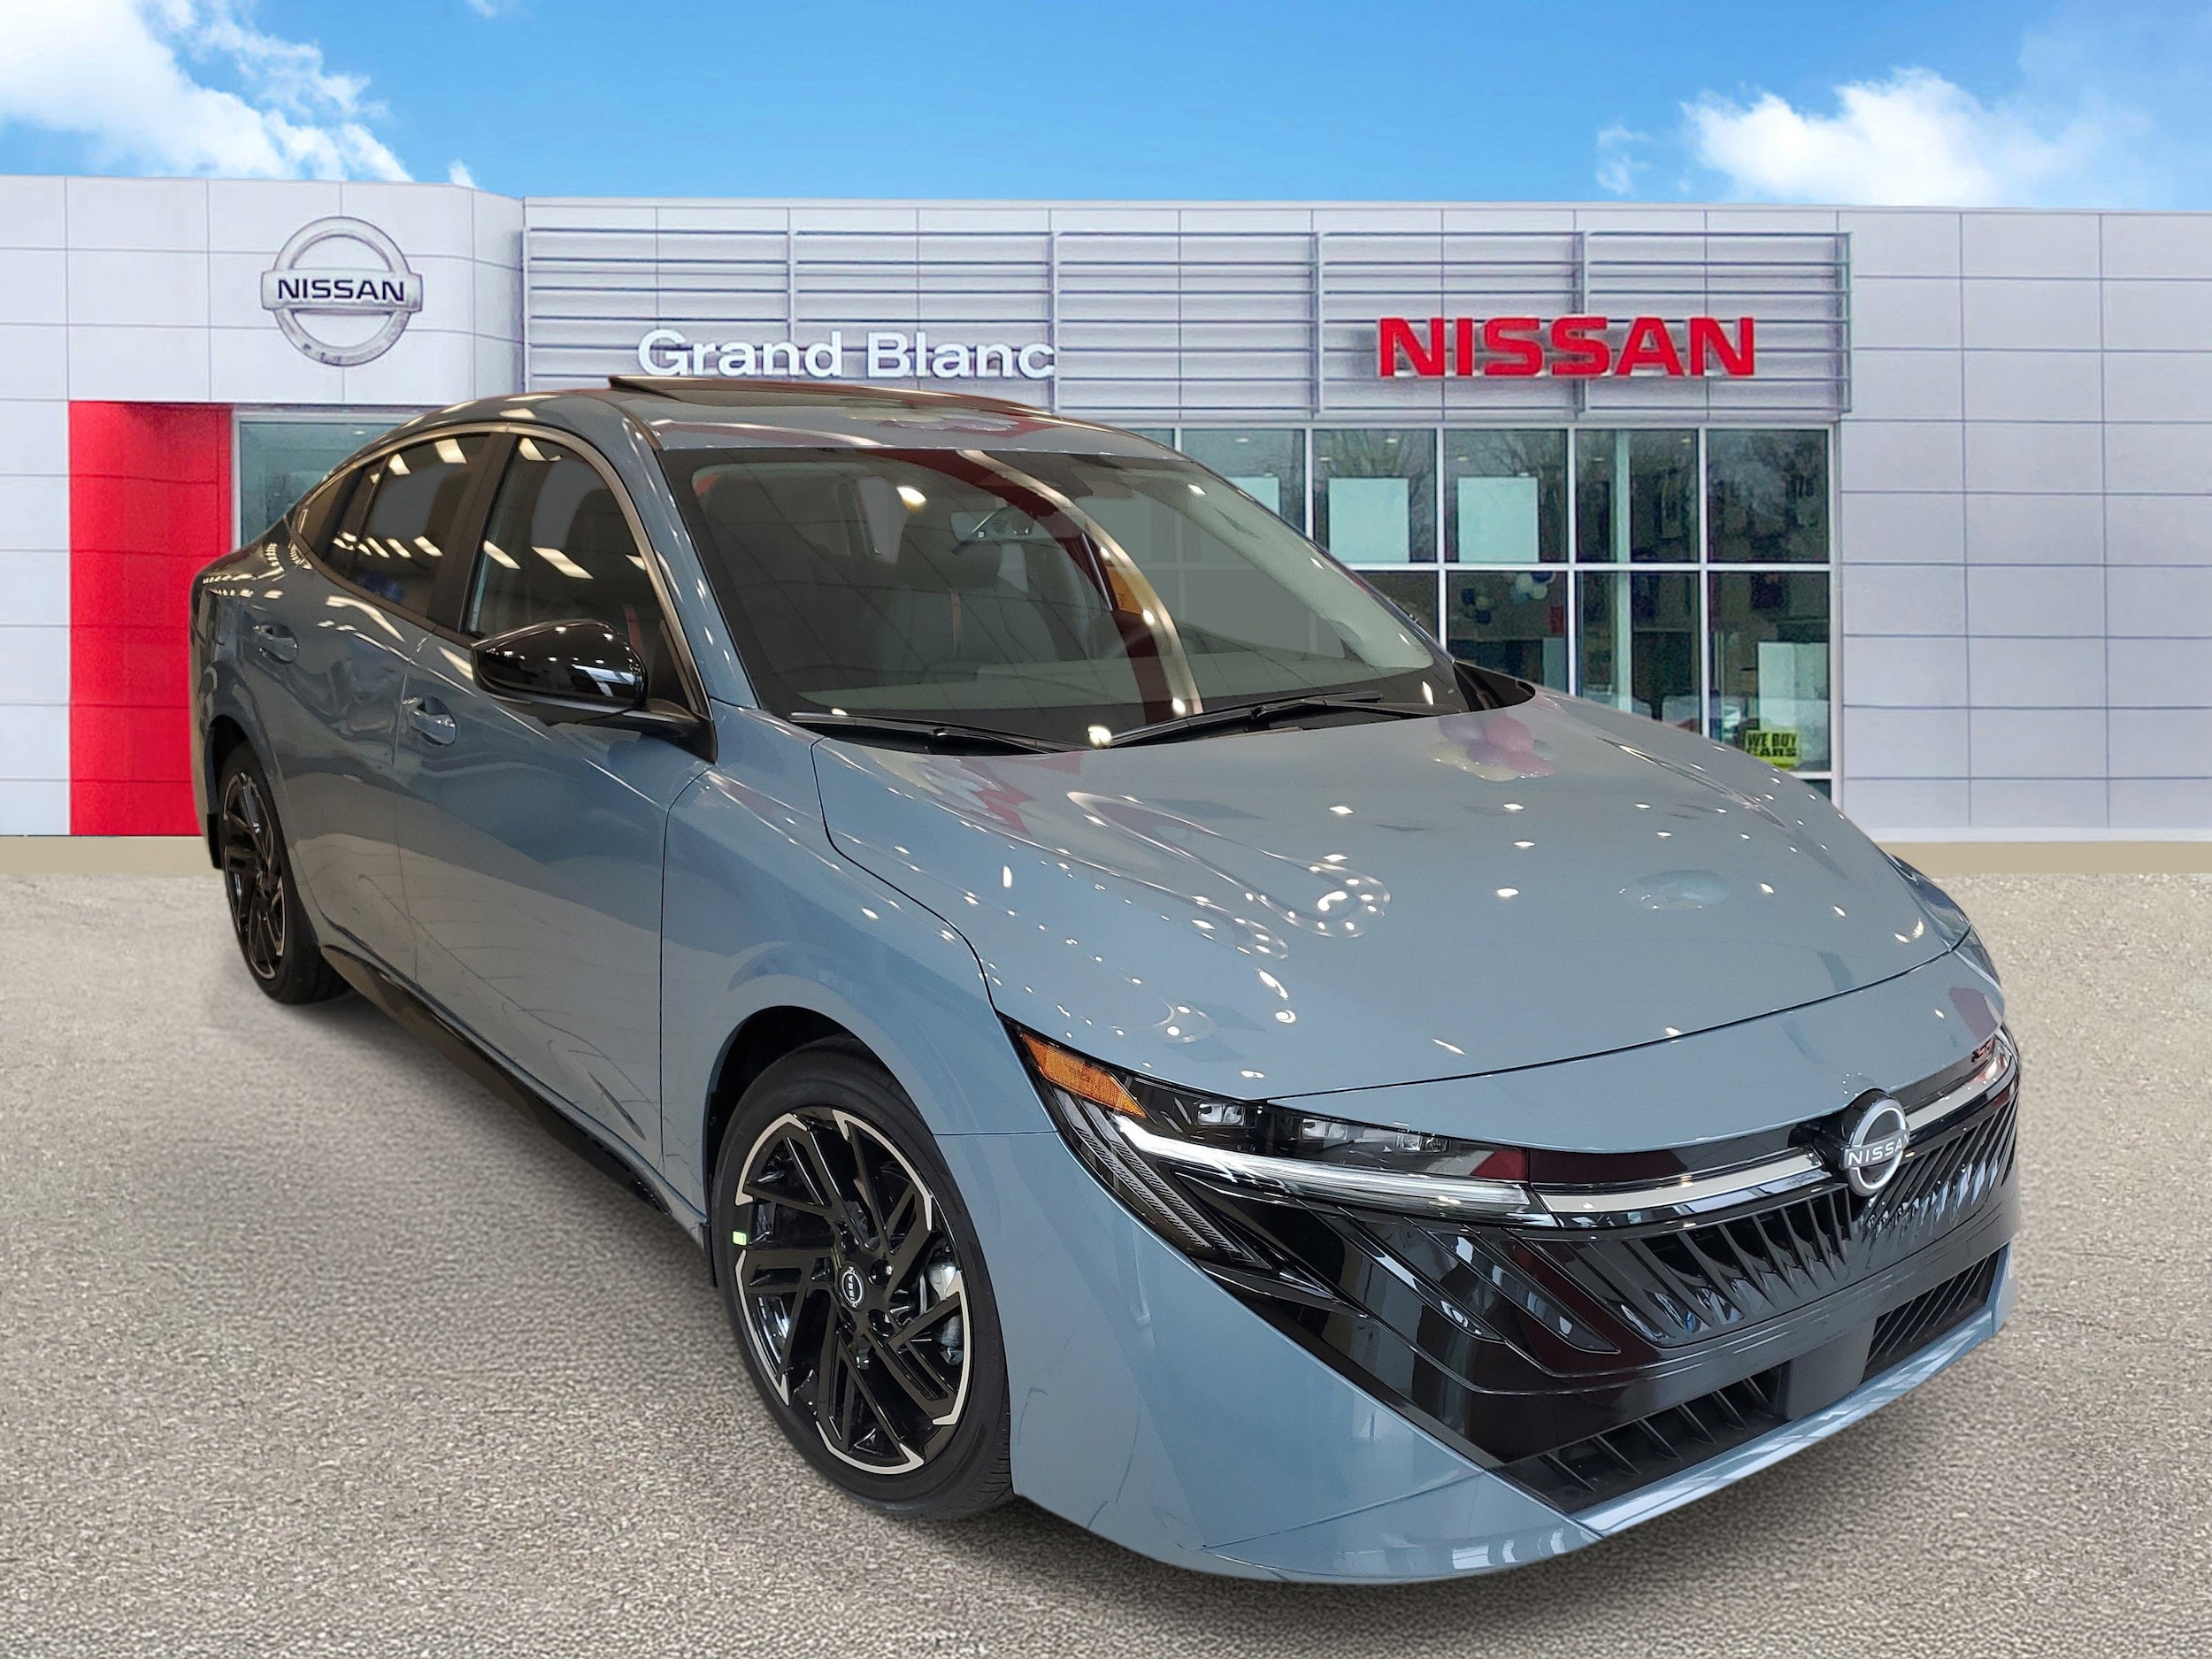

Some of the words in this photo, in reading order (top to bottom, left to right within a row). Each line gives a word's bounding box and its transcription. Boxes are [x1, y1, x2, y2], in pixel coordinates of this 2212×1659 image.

[278, 278, 404, 302] NISSAN
[637, 329, 841, 377] Grand
[867, 331, 1056, 379] Blanc
[1379, 317, 1755, 377] NISSAN
[1747, 733, 1767, 747] WE
[1772, 733, 1796, 747] BUY
[848, 1266, 857, 1309] NISSAN
